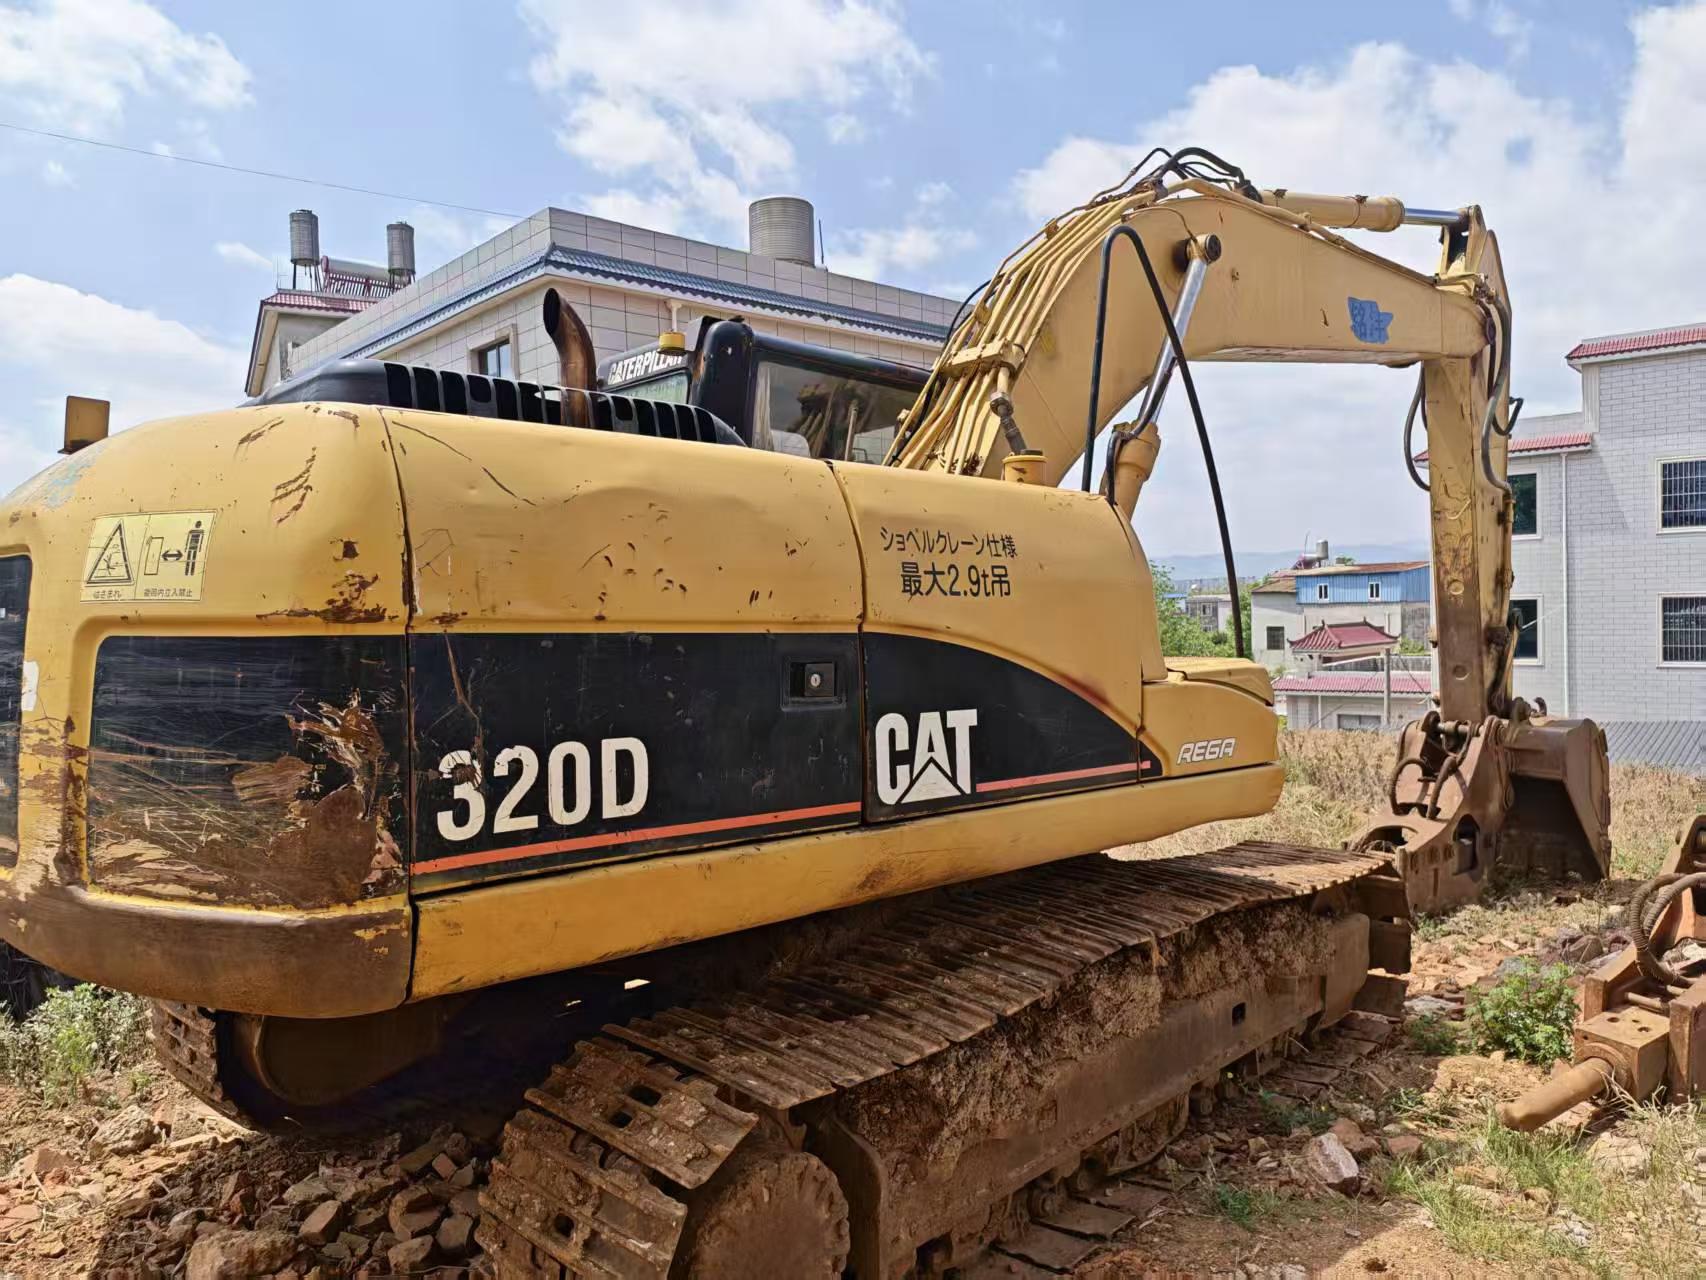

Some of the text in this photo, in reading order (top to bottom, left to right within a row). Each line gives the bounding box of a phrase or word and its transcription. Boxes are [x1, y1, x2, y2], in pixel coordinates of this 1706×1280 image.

[880, 526, 1018, 559] ショベルクレーン仕様
[901, 561, 1012, 598] 最大2.9t吊
[875, 708, 978, 806] CAT
[1176, 736, 1237, 765] REGA
[437, 736, 649, 841] 320D
